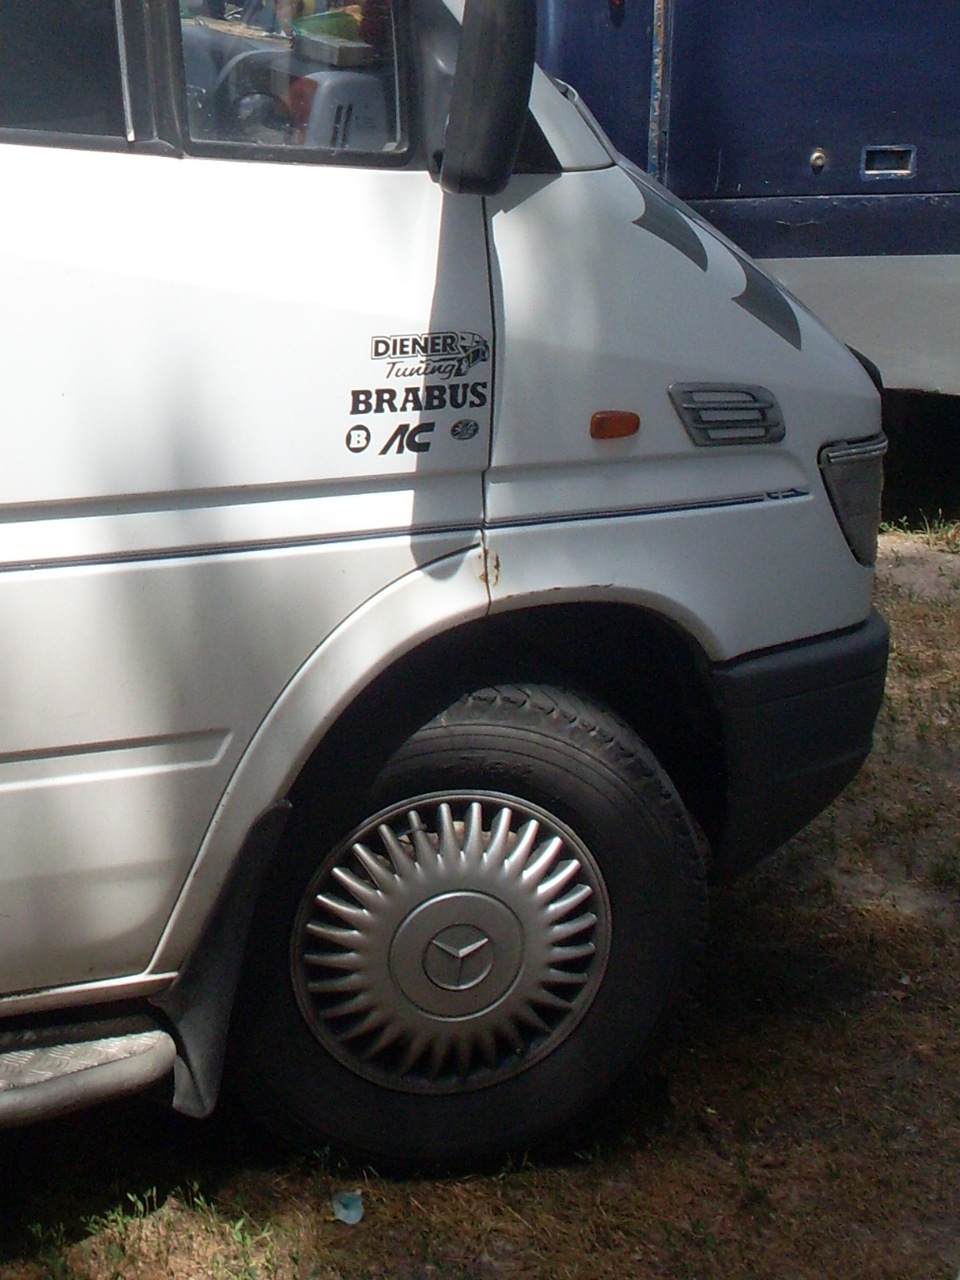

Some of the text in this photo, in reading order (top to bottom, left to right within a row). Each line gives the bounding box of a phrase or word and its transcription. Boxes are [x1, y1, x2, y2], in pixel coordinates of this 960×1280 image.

[373, 334, 458, 358] DIENER
[385, 360, 456, 381] Tuning
[349, 382, 488, 416] BRABUS
